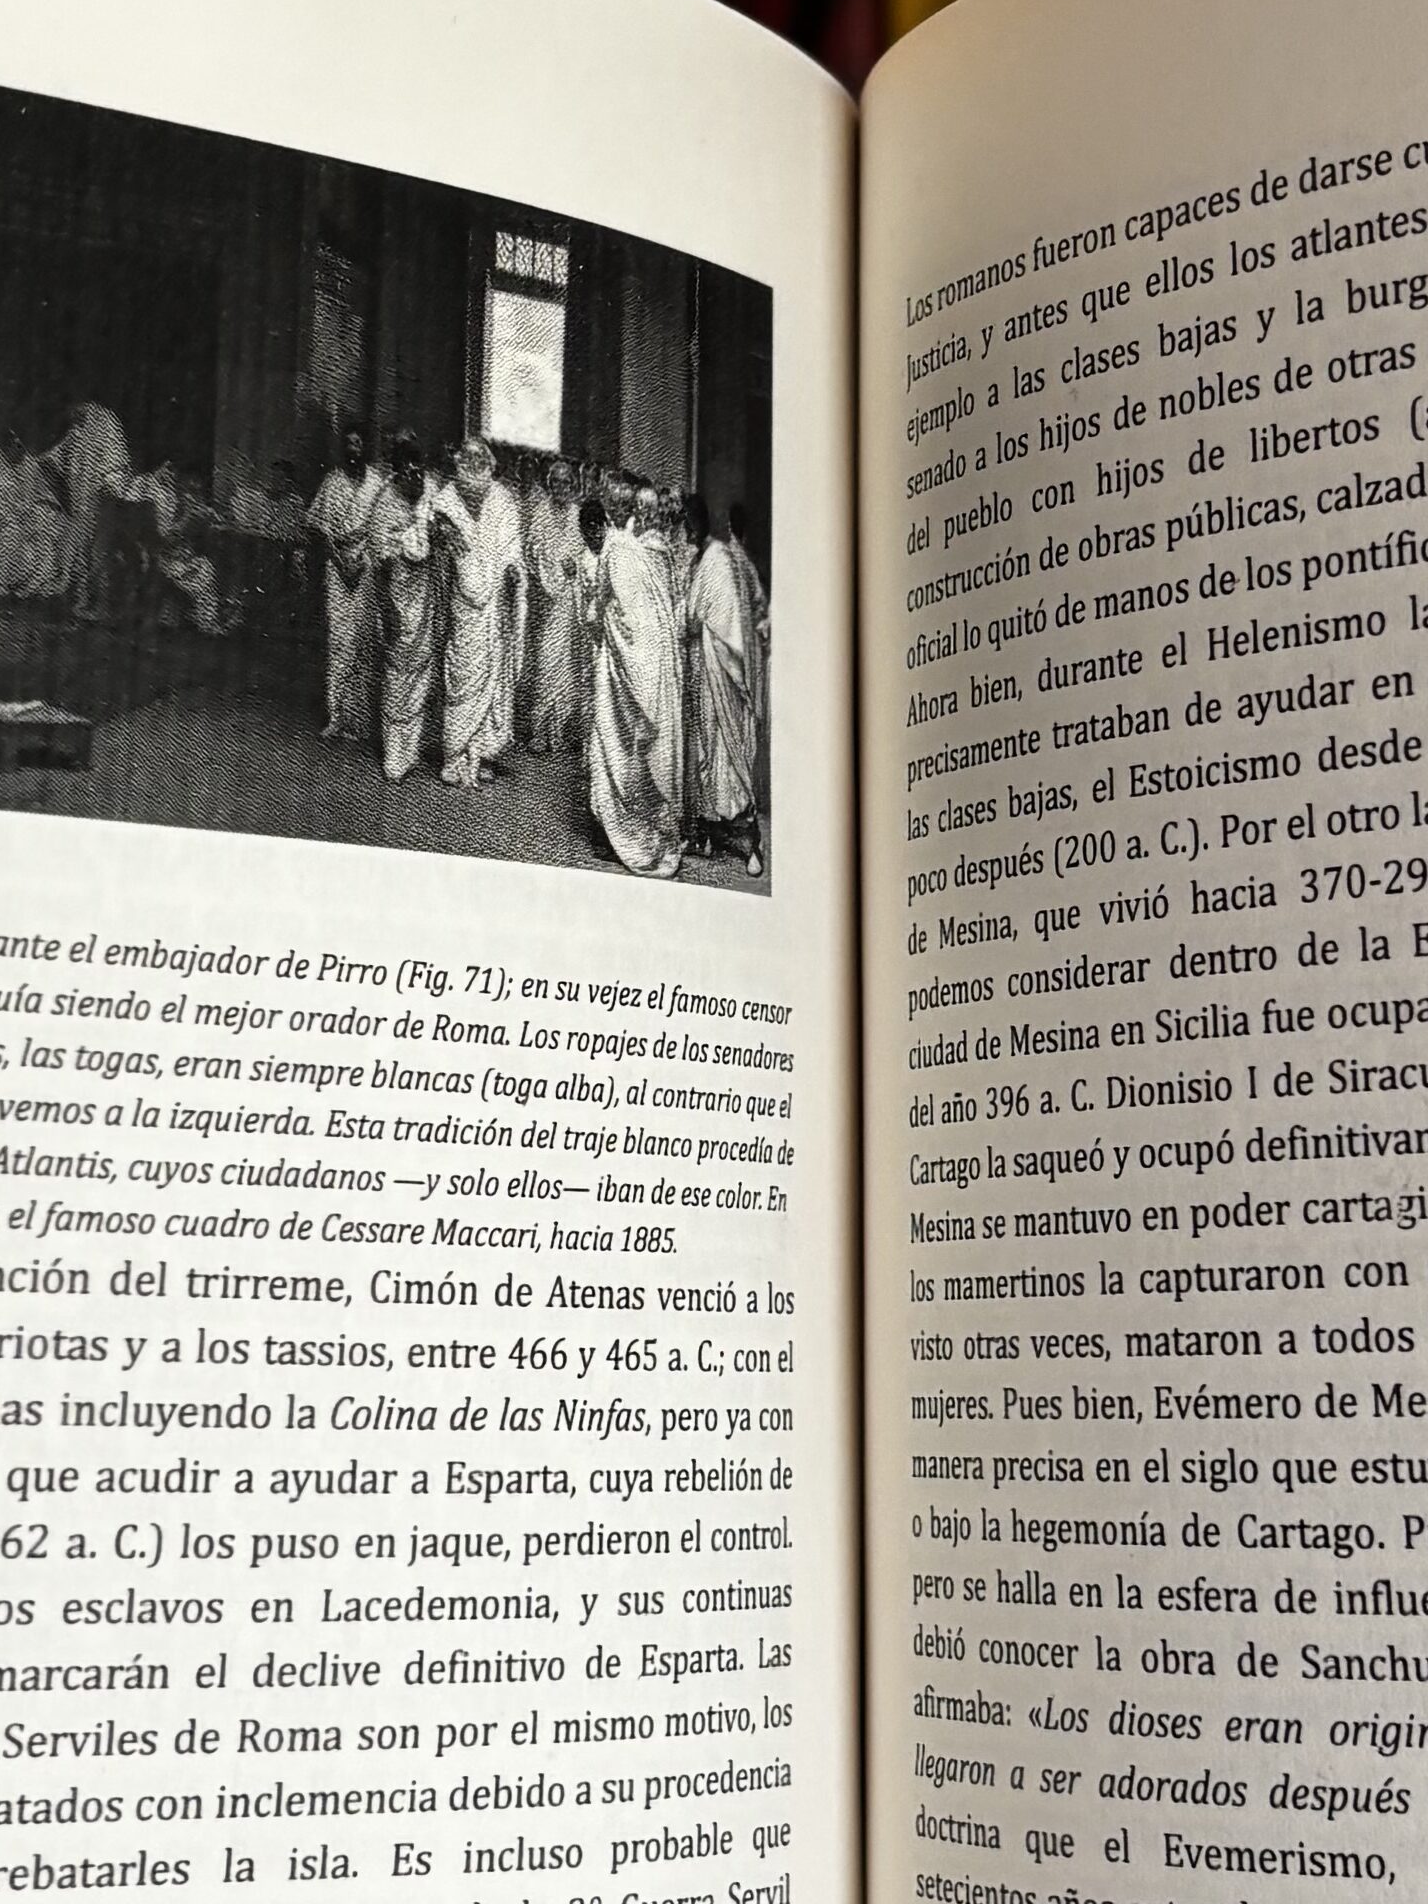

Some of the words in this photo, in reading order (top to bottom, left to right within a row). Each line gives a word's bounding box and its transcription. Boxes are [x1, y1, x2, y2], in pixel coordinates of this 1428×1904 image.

[906, 292, 934, 328] Los
[936, 252, 1027, 312] romanos
[1032, 222, 1117, 273] fueron
[1124, 186, 1241, 243] capaces
[1250, 168, 1289, 207] de
[1298, 149, 1393, 195] darse
[906, 515, 931, 556] del
[943, 490, 1013, 550] pueblo
[1031, 480, 1076, 513] con
[1095, 457, 1165, 500] hijos
[1187, 438, 1226, 476] de
[1248, 414, 1380, 463] libertos
[68, 933, 98, 964] el
[103, 938, 271, 979] embajador
[275, 949, 310, 980] de
[316, 953, 388, 986] Pirro
[395, 959, 454, 998] (Fig.
[464, 965, 514, 1002] 71);
[521, 977, 549, 1000] en
[554, 980, 581, 1003] su
[587, 983, 643, 1013] vejez
[647, 982, 666, 1011] el
[665, 984, 738, 1019] famoso
[741, 1000, 793, 1026] censor
[909, 1153, 982, 1190] Cartago
[986, 1144, 1008, 1180] la
[1012, 1136, 1105, 1184] saqueó
[1112, 1145, 1132, 1180] y
[1138, 1128, 1235, 1176] ocupó
[8, 1199, 38, 1230] el
[35, 1200, 156, 1239] famoso
[164, 1207, 270, 1240] cuadro
[279, 1210, 314, 1241] de
[321, 1212, 426, 1245] Cessare
[430, 1217, 542, 1254] Maccari,
[549, 1220, 614, 1252] hacia
[620, 1225, 676, 1254] 1885.
[109, 1259, 167, 1297] del
[185, 1265, 352, 1308] trirreme,
[370, 1269, 478, 1306] Cimón
[494, 1271, 533, 1308] de
[545, 1274, 646, 1311] Atenas
[656, 1280, 737, 1313] venció
[746, 1290, 759, 1314] a
[767, 1280, 795, 1315] los
[910, 1329, 954, 1362] visto
[963, 1331, 1021, 1361] otras
[1029, 1333, 1112, 1363] veces,
[1123, 1326, 1263, 1358] mataron
[1278, 1329, 1299, 1356] a
[1311, 1316, 1416, 1355] todos
[6, 1467, 80, 1503] que
[95, 1456, 221, 1494] acudir
[234, 1468, 254, 1494] a
[269, 1458, 399, 1504] ayudar
[410, 1469, 429, 1495] a
[444, 1460, 577, 1504] Esparta,
[589, 1468, 654, 1503] cuya
[664, 1457, 763, 1493] rebelión
[769, 1456, 793, 1491] de
[62, 1587, 225, 1625] esclavos
[250, 1598, 294, 1624] en
[321, 1585, 559, 1624] Lacedemonia,
[578, 1593, 599, 1627] y
[617, 1590, 665, 1617] sus
[682, 1578, 793, 1614] continuas
[222, 1846, 255, 1884] la
[288, 1843, 358, 1881] isla.
[391, 1842, 433, 1877] Es
[462, 1835, 583, 1874] incluso
[610, 1821, 734, 1875] probable
[752, 1822, 792, 1859] que
[915, 1803, 1002, 1850] doctrina
[1025, 1829, 1075, 1865] que
[1103, 1827, 1131, 1864] el
[1163, 1832, 1396, 1886] Evemerismo,
